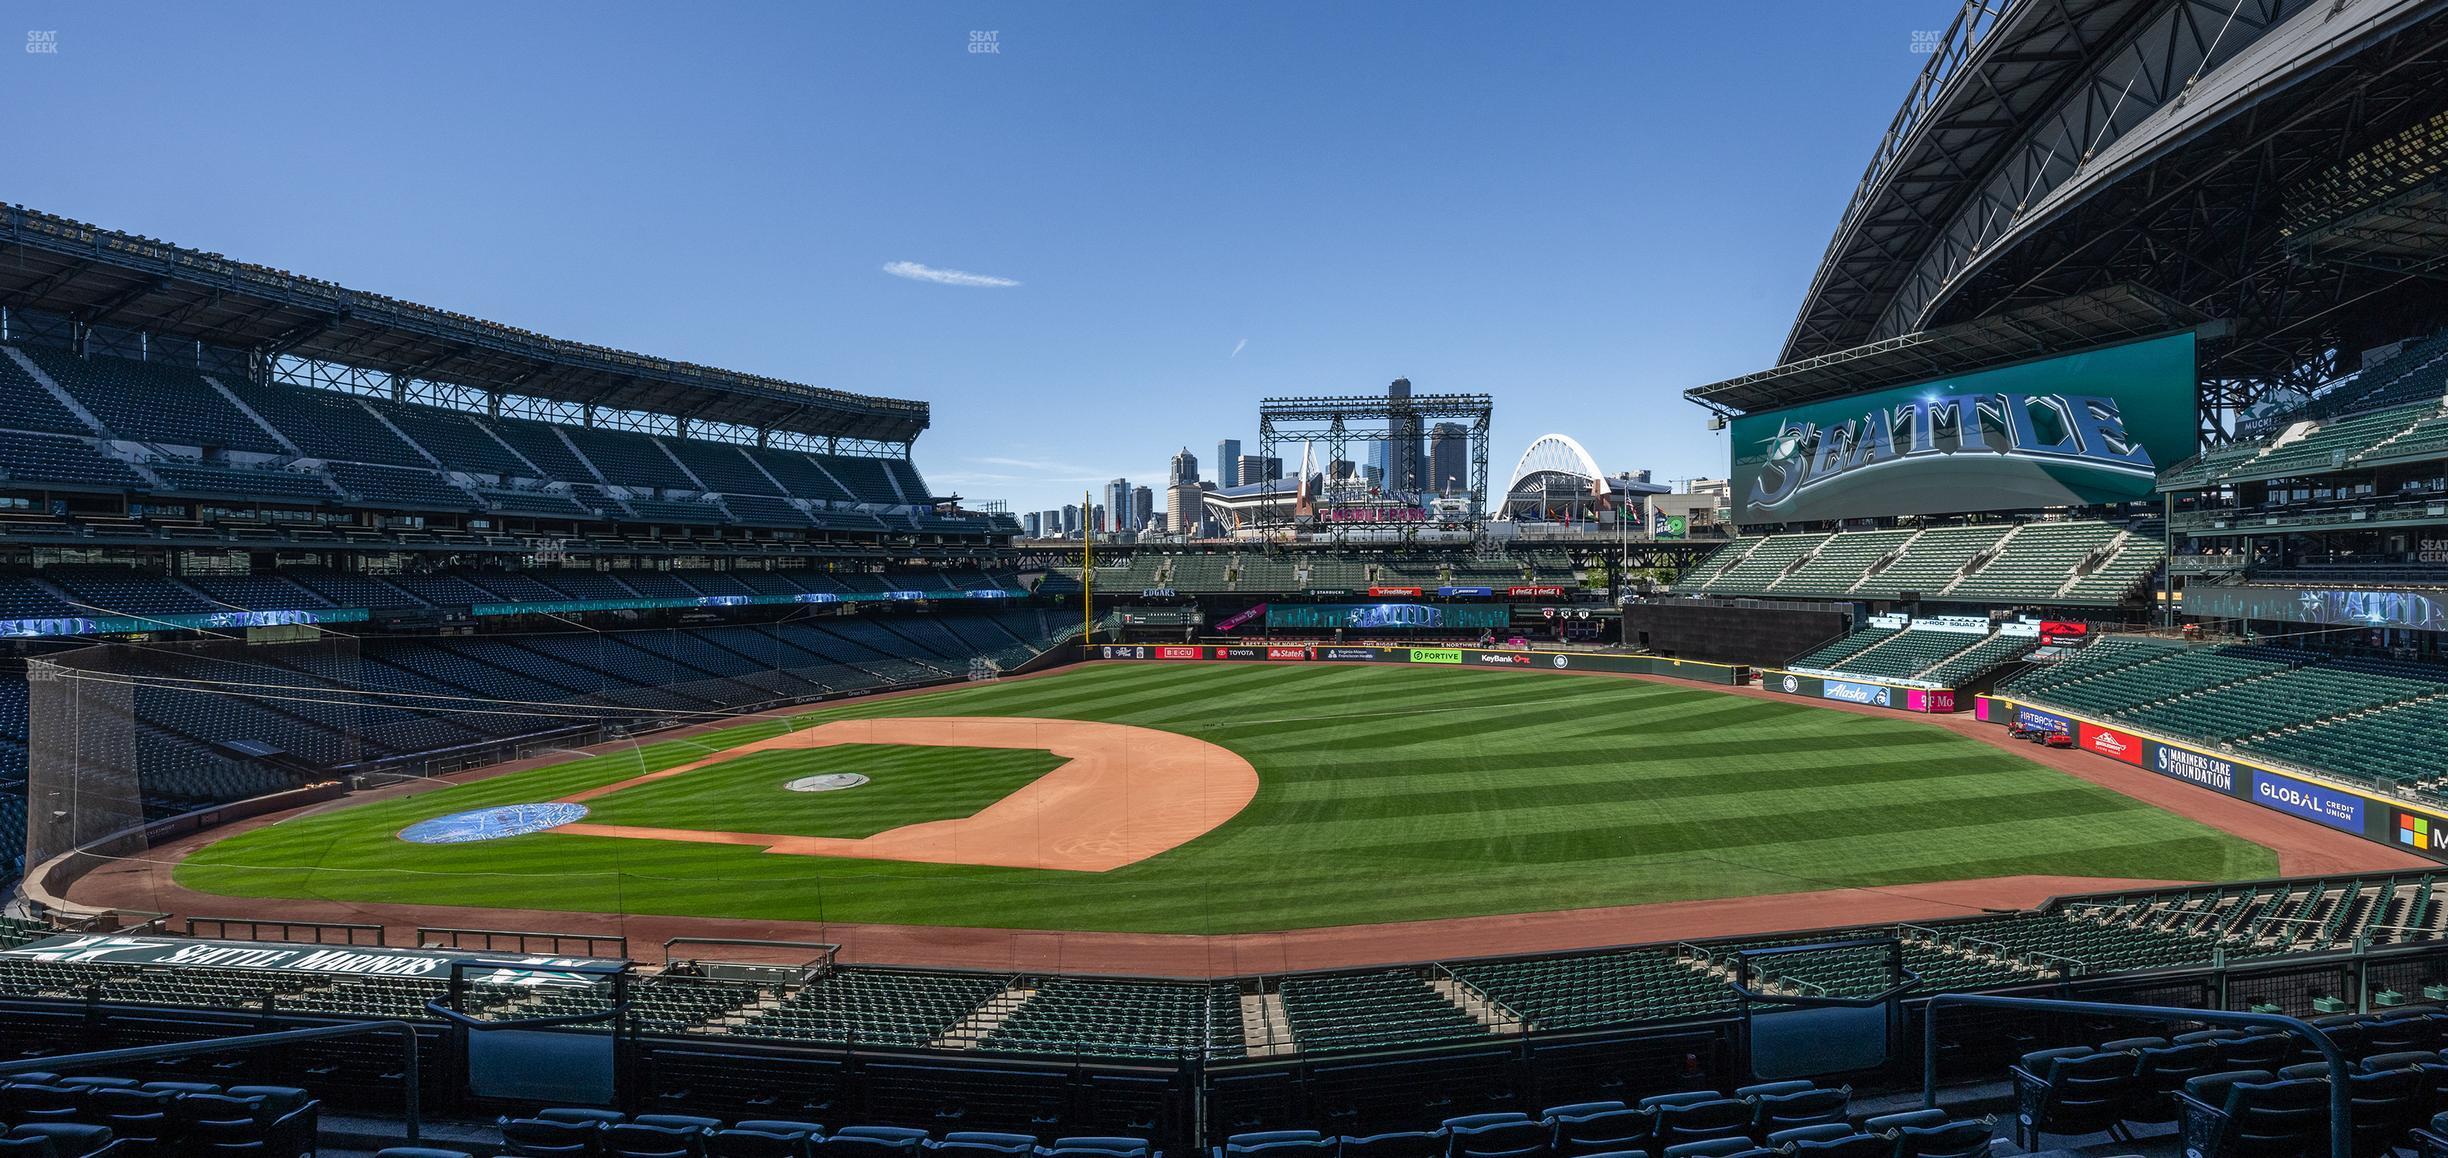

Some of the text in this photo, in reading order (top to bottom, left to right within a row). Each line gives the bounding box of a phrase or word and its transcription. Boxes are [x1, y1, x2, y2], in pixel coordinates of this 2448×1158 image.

[1747, 393, 2157, 508] SEATTLE
[1389, 507, 1427, 521] PARK
[1166, 648, 1193, 656] BECU
[1424, 652, 1459, 660] FORTIVE
[1481, 654, 1513, 664] KeyBank
[1826, 683, 1867, 700] Alaska
[2170, 748, 2231, 776] MARINERS CARE
[2170, 760, 2231, 790] FOUNDATION
[2260, 782, 2322, 813] GLOBAL
[2326, 800, 2355, 814] CREDIT
[2326, 808, 2351, 821] UNION
[152, 944, 448, 975] SEATTLE MARINERS
